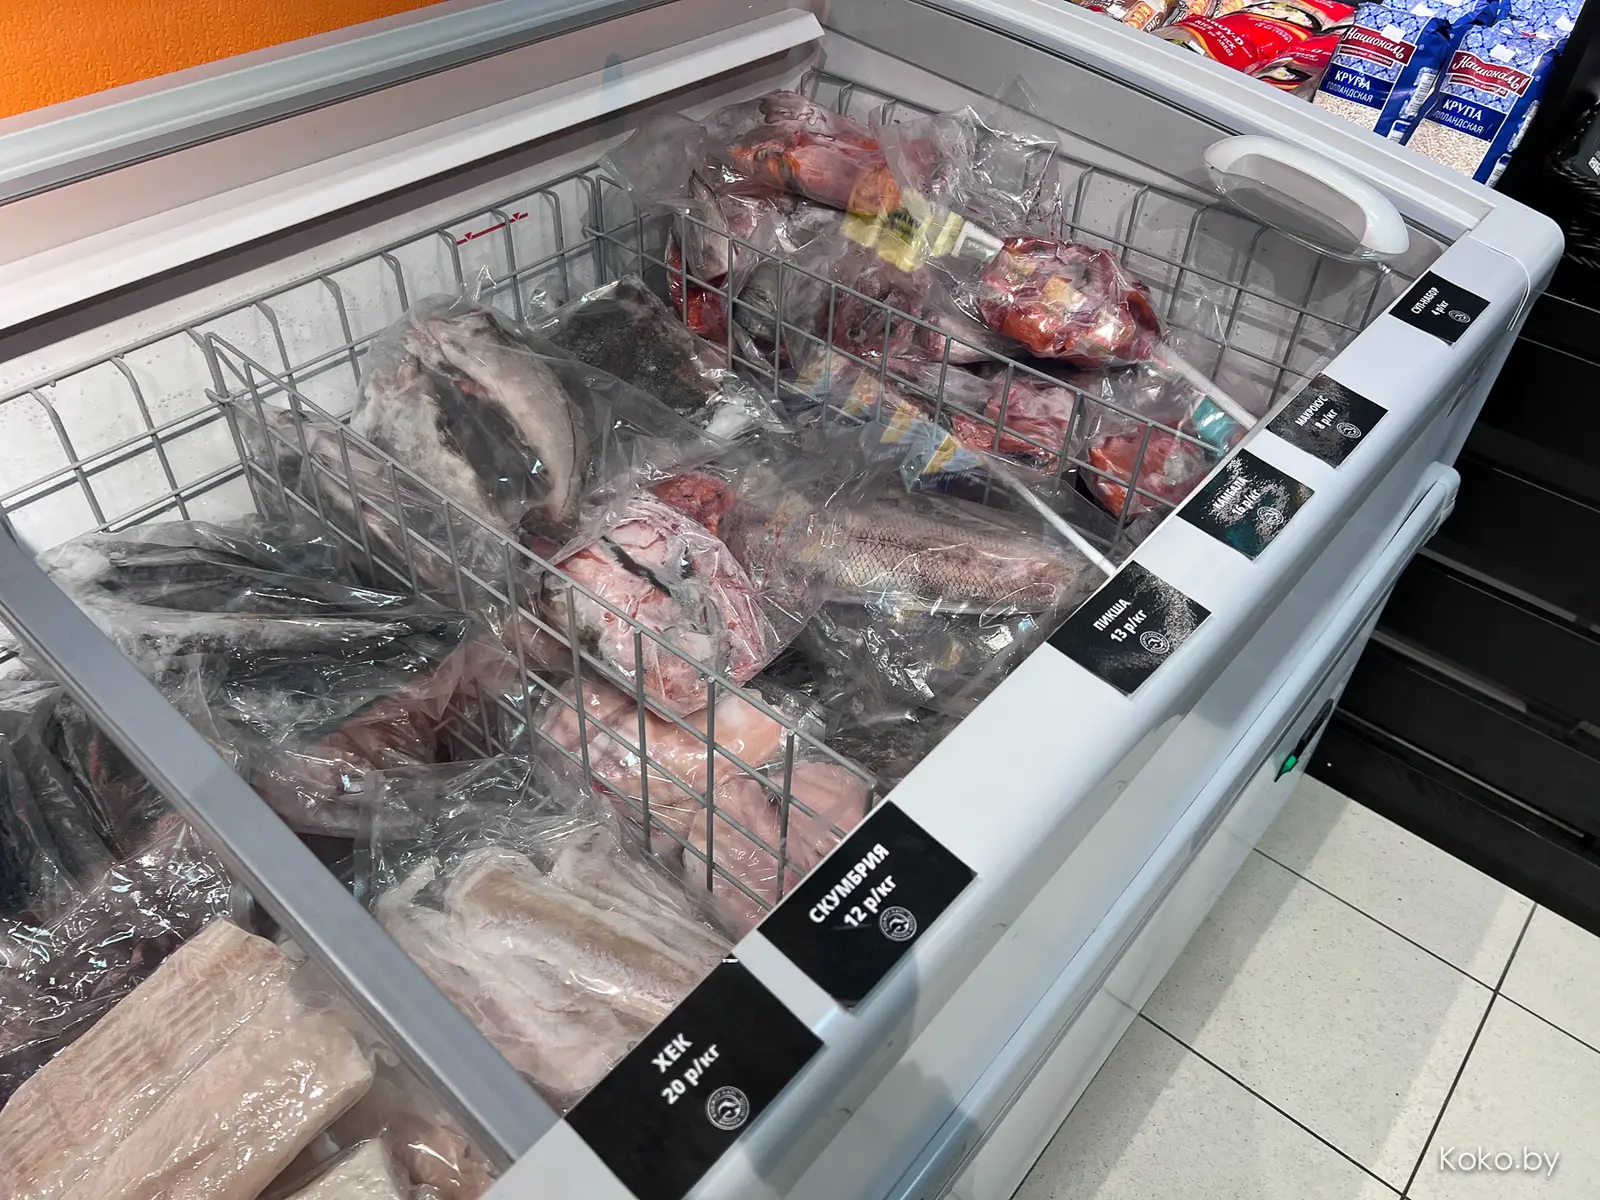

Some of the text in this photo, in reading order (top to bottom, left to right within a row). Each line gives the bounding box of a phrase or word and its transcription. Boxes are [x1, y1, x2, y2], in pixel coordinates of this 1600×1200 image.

[1215, 31, 1237, 50] STICK
[1343, 27, 1404, 60] Националь
[1334, 70, 1371, 91] КРУПА
[1442, 99, 1483, 121] КРУПА
[1410, 286, 1440, 315] СУП-НАБОР
[1436, 300, 1449, 315] р/кг
[1294, 394, 1329, 427] МАКРОКУС
[1314, 421, 1325, 430] 8
[1321, 408, 1338, 428] р/кг
[1212, 476, 1249, 510] КАМБАЛА
[1231, 504, 1246, 516] 16
[1243, 488, 1262, 510] р/кг
[1092, 598, 1131, 632] ПИКША
[1109, 628, 1128, 643] 13
[1123, 609, 1148, 635] р/кг
[808, 842, 891, 924] СКУМБРИЯ
[842, 903, 869, 929] 12
[862, 875, 898, 914] р/кг
[650, 1032, 693, 1075] ХЕК
[661, 1043, 721, 1106] 20 р/кг
